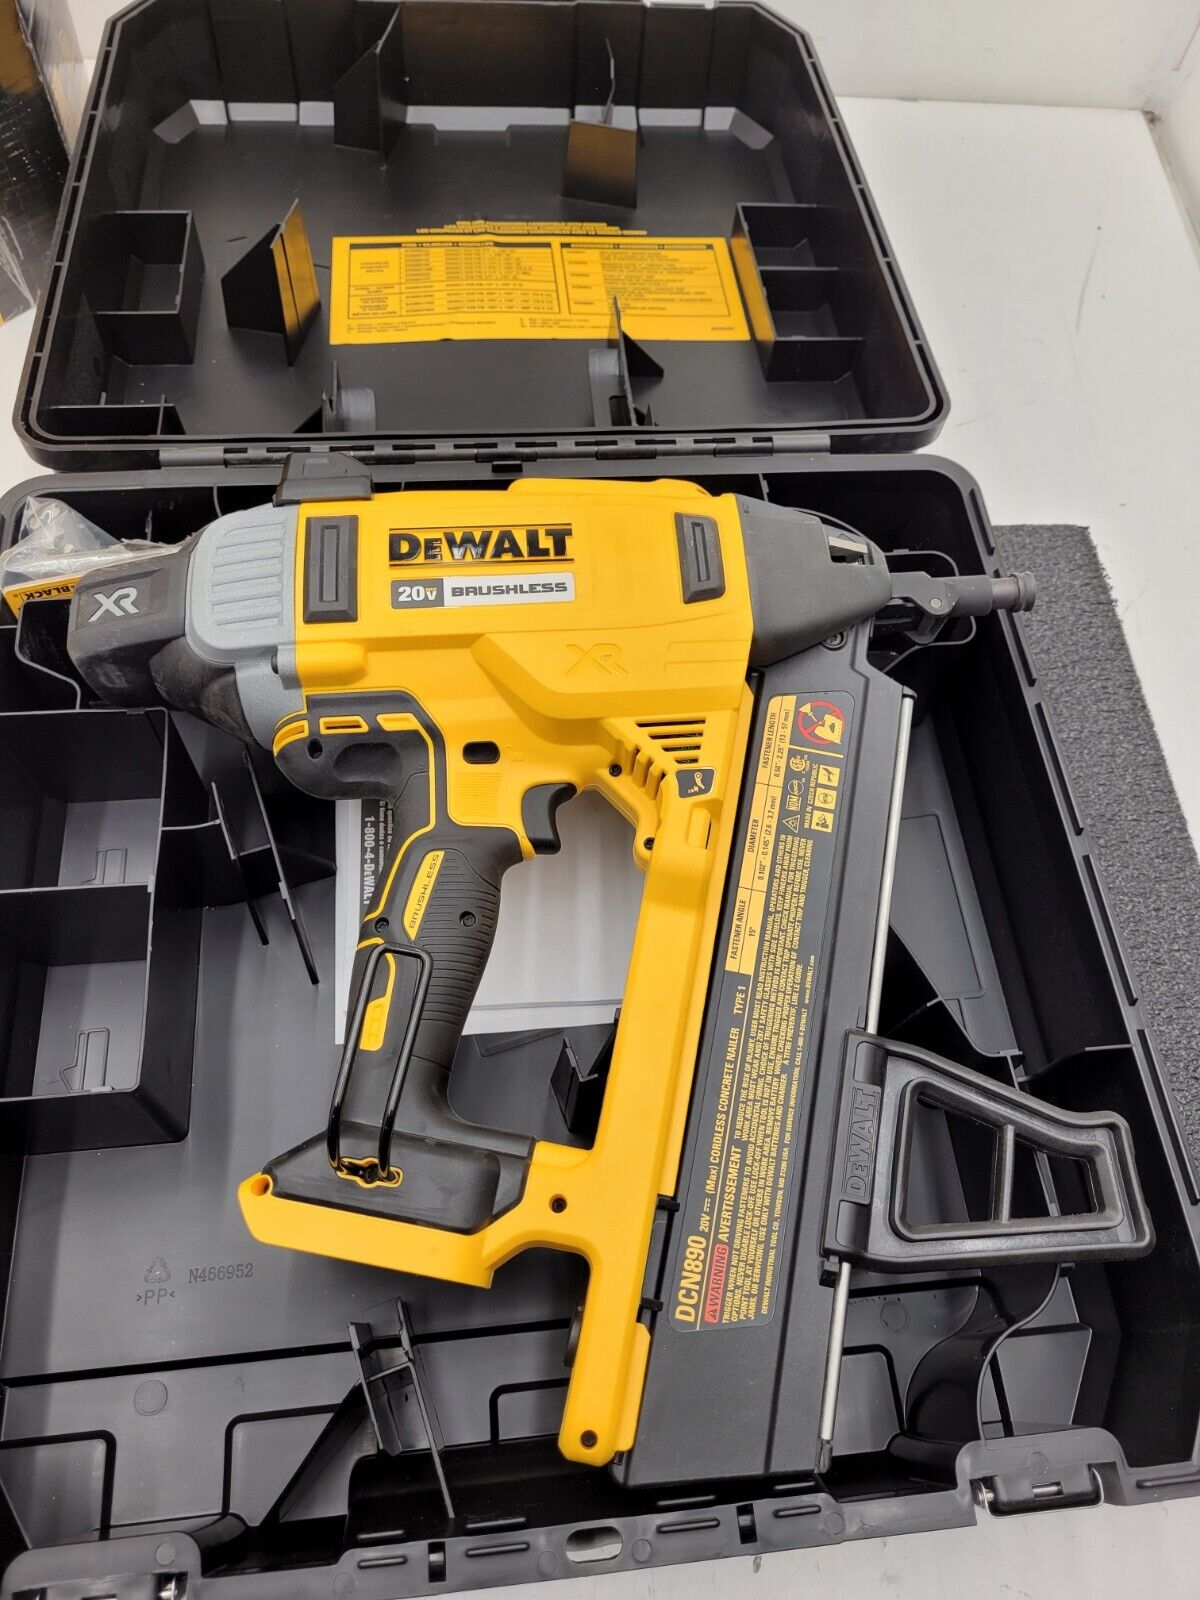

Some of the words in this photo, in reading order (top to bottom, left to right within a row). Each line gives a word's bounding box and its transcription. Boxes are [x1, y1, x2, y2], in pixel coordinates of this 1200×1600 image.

[389, 528, 573, 562] DEWALT
[24, 585, 71, 601] BLACK
[451, 582, 568, 597] BRUSHLESS
[88, 586, 140, 623] XR
[565, 642, 629, 676] XR
[767, 712, 777, 736] LENGTH
[782, 709, 790, 722] mm)
[762, 738, 773, 768] FASTENER
[810, 764, 818, 787] REPUBLIC
[788, 795, 799, 810] NOM
[807, 788, 815, 804] CZECH
[765, 824, 773, 835] (2.6
[769, 796, 777, 809] mm)
[748, 819, 759, 852] DIAMETER
[785, 835, 793, 852] FROM
[799, 838, 807, 857] NEVER
[776, 842, 785, 864] OTHERS
[783, 852, 791, 870] AWAY
[790, 837, 800, 871] TRIGGERING
[804, 840, 813, 867] CLEARING
[774, 864, 782, 878] AND
[779, 870, 788, 896] FINGERS
[793, 870, 802, 893] BEFORE
[409, 853, 440, 929] BRUSHLESS
[769, 878, 780, 912] OPERATORS
[784, 884, 793, 910] MANUAL
[798, 894, 806, 907] AND
[776, 896, 784, 911] KEEP
[789, 893, 799, 922] PROPERLY
[796, 908, 804, 921] TRIP
[730, 924, 742, 959] FASTENER
[736, 900, 746, 922] ANGLE
[748, 927, 756, 937] 15°
[781, 910, 789, 930] CHECK
[770, 939, 778, 954] SIDE
[785, 922, 795, 949] OPERATE
[792, 922, 802, 948] CONTACT
[758, 941, 770, 982] INSTRUCTION
[767, 954, 776, 971] WITH
[783, 949, 791, 963] TRIP
[763, 972, 773, 1000] GLASSES
[770, 975, 780, 1002] METHOD
[779, 963, 789, 992] CONTACT
[786, 960, 796, 994] OPERATION
[734, 991, 745, 1014] TYPE
[756, 983, 764, 1000] READ
[777, 992, 785, 1006] AND
[753, 1000, 761, 1019] MUST
[760, 1000, 769, 1024] SAFETY
[782, 995, 791, 1019] PROPER
[750, 1020, 758, 1037] USER
[765, 1003, 776, 1041] TRIGGERING
[773, 1007, 783, 1034] TRIGGER
[726, 1028, 739, 1062] NAILER
[769, 1034, 779, 1060] ENSURE
[778, 1020, 788, 1052] CHECKING
[754, 1042, 763, 1059] ANSI
[784, 1041, 792, 1059] TITRE
[751, 1059, 760, 1080] WEAR
[759, 1051, 769, 1076] CHOICE
[718, 1062, 734, 1112] CONCRETE
[742, 1073, 750, 1088] RISK
[748, 1080, 757, 1100] MUST
[764, 1084, 772, 1099] NOT
[770, 1078, 780, 1106] BATTERY
[740, 1089, 748, 1102] THE
[736, 1103, 746, 1129] REDUCE
[745, 1101, 754, 1119] AREA
[750, 1101, 761, 1143] ACCIDENTAL
[760, 1107, 768, 1124] TOOL
[766, 1107, 776, 1135] REMOVE
[775, 1105, 783, 1121] AND
[786, 1108, 795, 1131] SERVICE
[710, 1112, 726, 1165] CORDLESS
[742, 1120, 751, 1140] WORK
[757, 1125, 766, 1146] WHEN
[770, 1121, 781, 1158] BATTERIES
[746, 1143, 755, 1166] AVOID
[846, 1087, 877, 1198] DEWALT
[752, 1146, 763, 1180] LOCK-OFF
[760, 1157, 769, 1178] WORK
[766, 1158, 776, 1186] DEWALT
[705, 1165, 718, 1194] (Max)
[750, 1180, 758, 1194] USE
[739, 1177, 750, 1218] FASTENERS
[754, 1188, 764, 1216] OTHERS
[763, 1187, 772, 1206] WITH
[699, 1214, 711, 1232] 20V
[708, 1246, 727, 1305] WARNING
[718, 1145, 742, 1242] AVERTISSEMENT
[761, 1206, 769, 1226] ONLY
[734, 1218, 744, 1249] DRIVING
[740, 1230, 751, 1261] DISABLE
[758, 1226, 767, 1242] USE
[770, 1231, 778, 1248] TOOL
[731, 1250, 740, 1266] NOT
[747, 1228, 759, 1264] YOURSELF
[188, 1262, 254, 1284] N466952
[674, 1235, 708, 1323] DCN890
[728, 1267, 737, 1291] WHEN
[736, 1262, 746, 1287] NEVER
[765, 1248, 776, 1286] INDUSTRIAL
[743, 1276, 752, 1296] TOOL
[723, 1291, 734, 1323] TRIGGER
[740, 1297, 749, 1320] POINT
[762, 1287, 771, 1314] DEWALT
